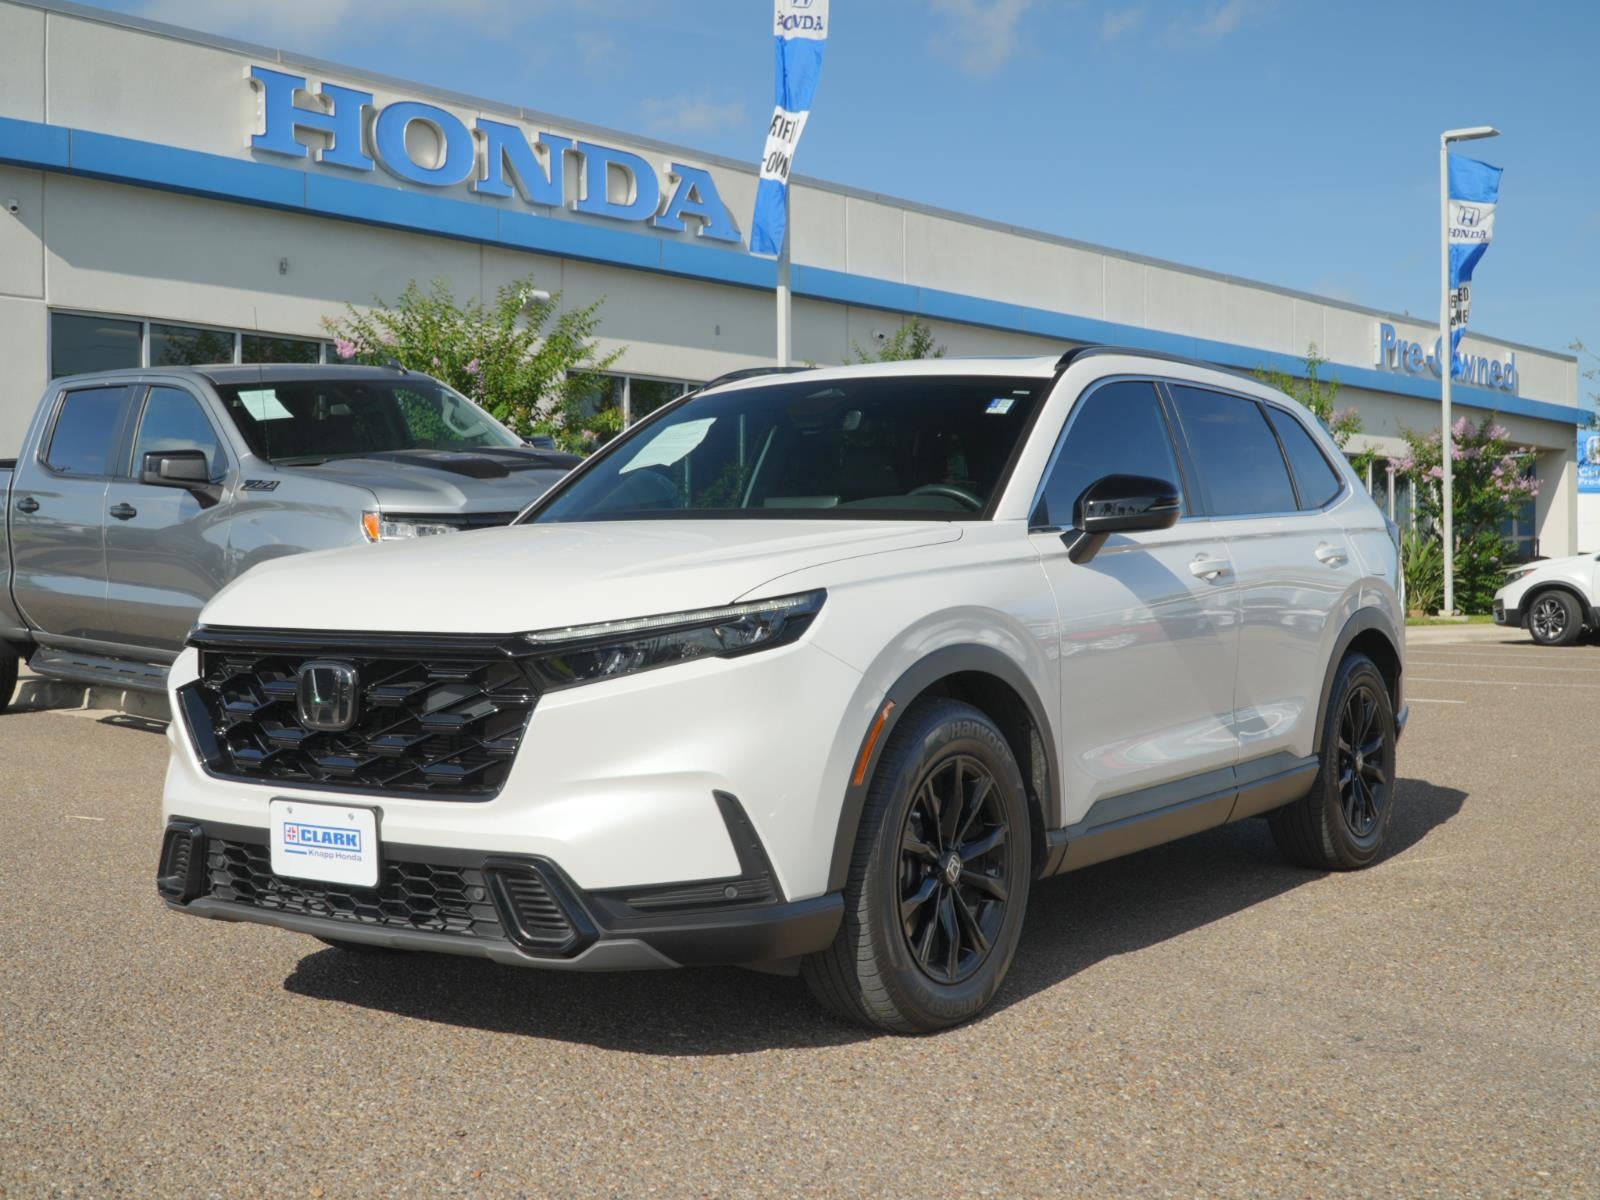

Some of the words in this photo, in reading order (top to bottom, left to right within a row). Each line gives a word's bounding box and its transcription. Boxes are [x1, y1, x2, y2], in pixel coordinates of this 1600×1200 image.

[246, 64, 742, 243] HONDA
[300, 828, 358, 847] CLARK
[308, 849, 334, 860] Knapp
[335, 852, 362, 862] Honda
